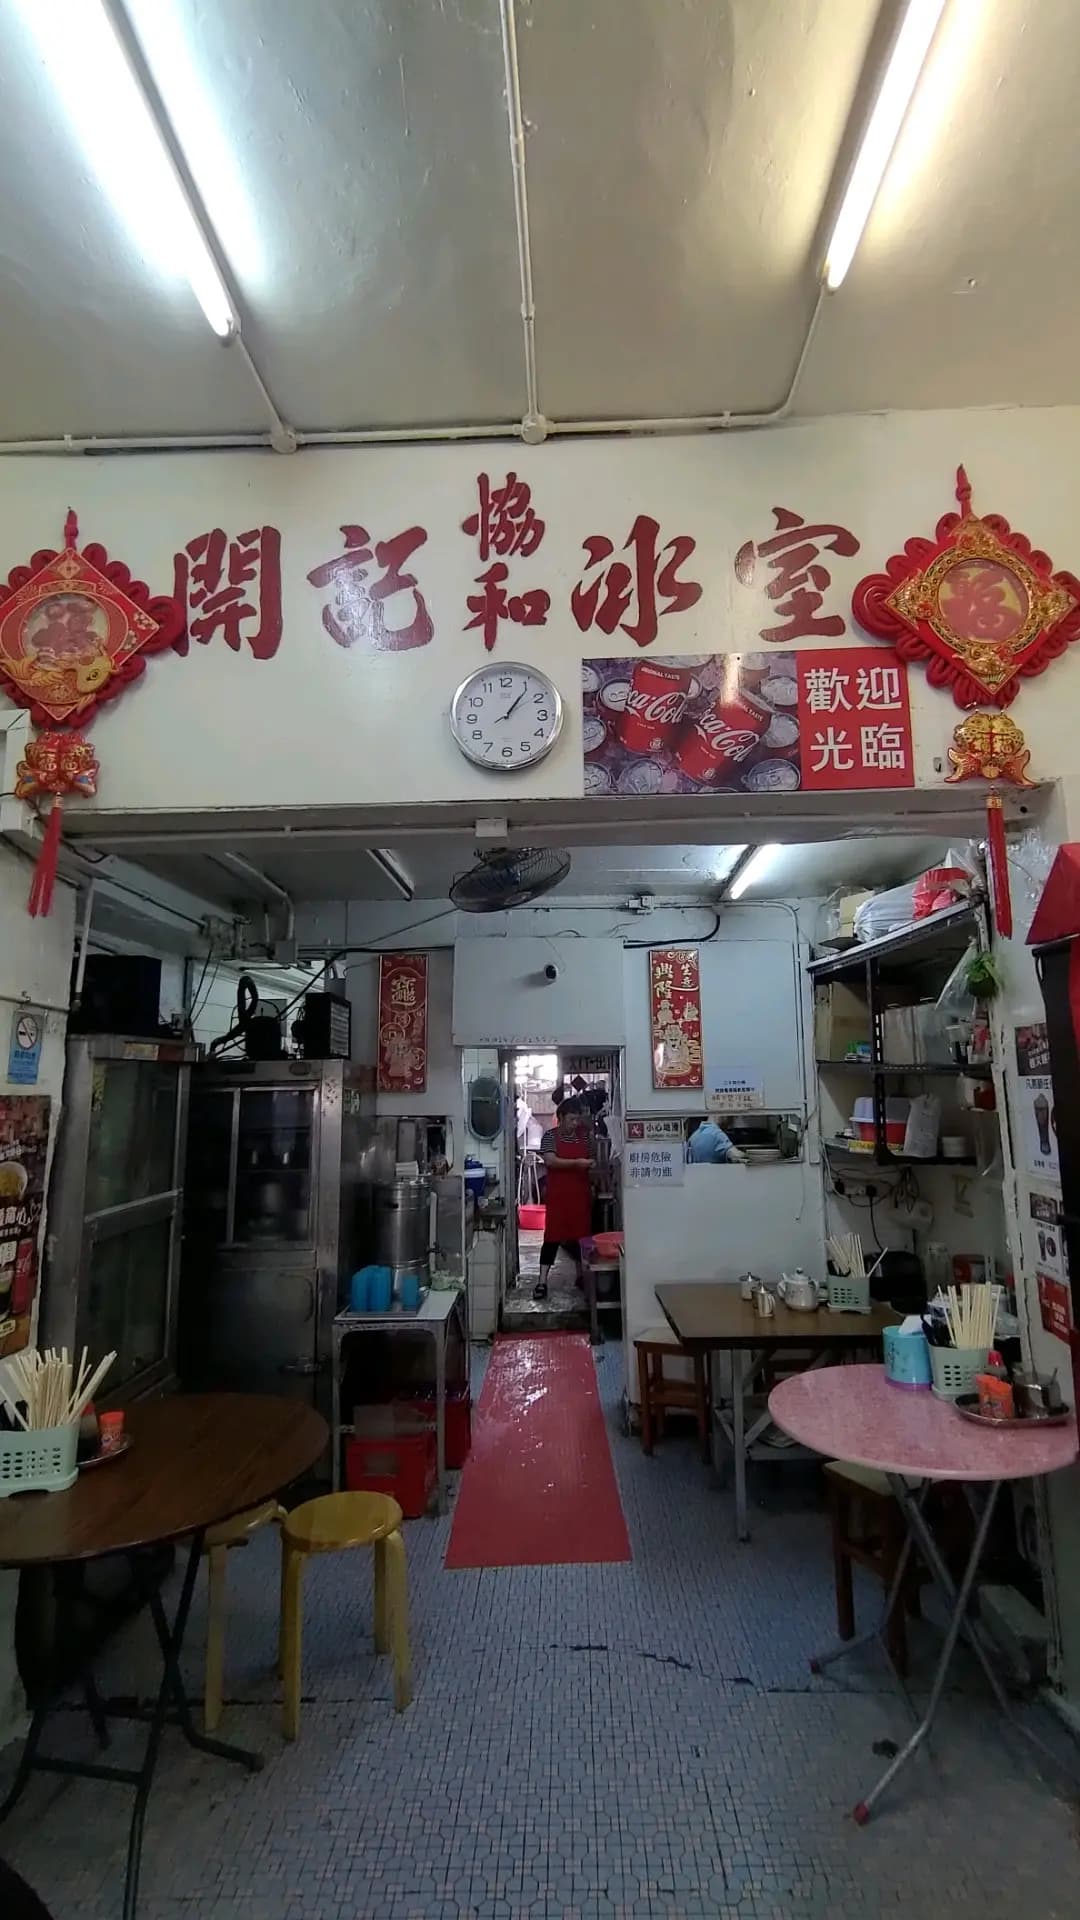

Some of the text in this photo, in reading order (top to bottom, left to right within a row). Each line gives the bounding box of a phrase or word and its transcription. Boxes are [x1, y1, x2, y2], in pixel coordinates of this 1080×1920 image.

[571, 508, 860, 648] 冰室
[482, 682, 493, 693] 11
[498, 677, 513, 688] 12
[804, 667, 902, 713] 歡迎
[469, 697, 484, 708] 10
[533, 693, 544, 704] 2
[466, 713, 478, 724] 9
[537, 709, 548, 721] 3
[471, 730, 482, 740] 8
[533, 728, 545, 738] 4
[483, 742, 493, 753] 7
[502, 746, 513, 757] 6
[520, 741, 531, 752] 5
[810, 722, 905, 772] 光臨
[654, 963, 674, 999] 興隆
[681, 963, 694, 988] 生意
